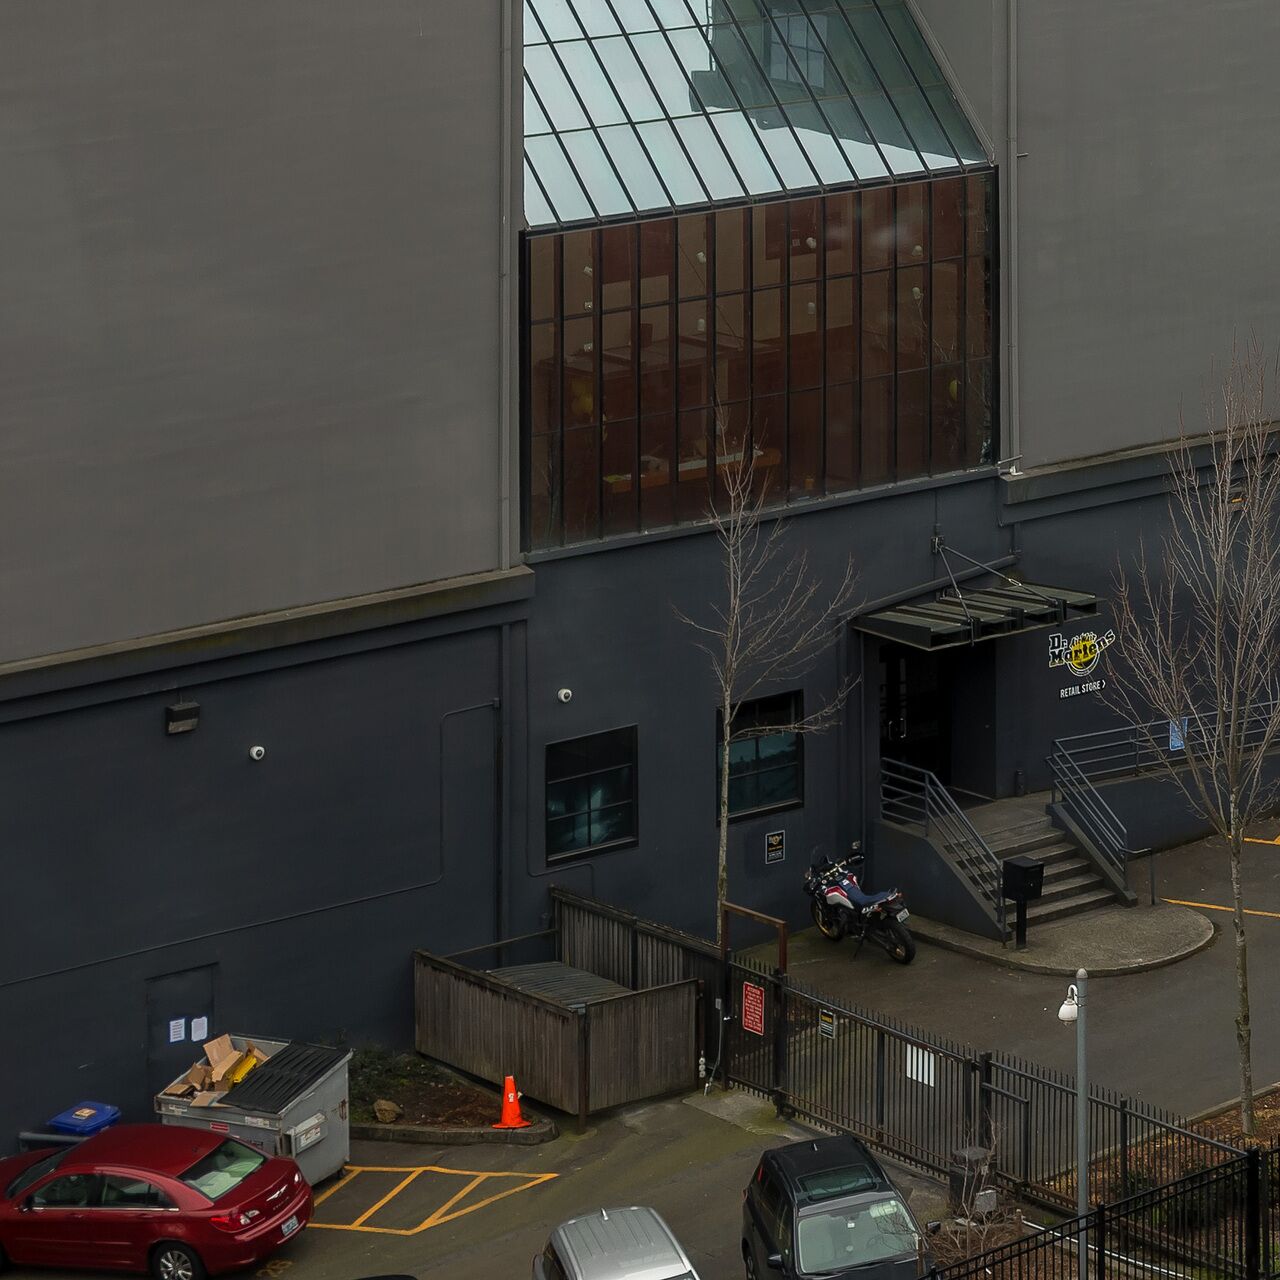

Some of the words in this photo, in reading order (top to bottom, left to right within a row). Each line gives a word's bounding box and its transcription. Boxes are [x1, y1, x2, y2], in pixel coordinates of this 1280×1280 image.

[1049, 629, 1116, 668] Martens
[1060, 686, 1081, 698] RETAIL
[1081, 680, 1101, 693] STORE
